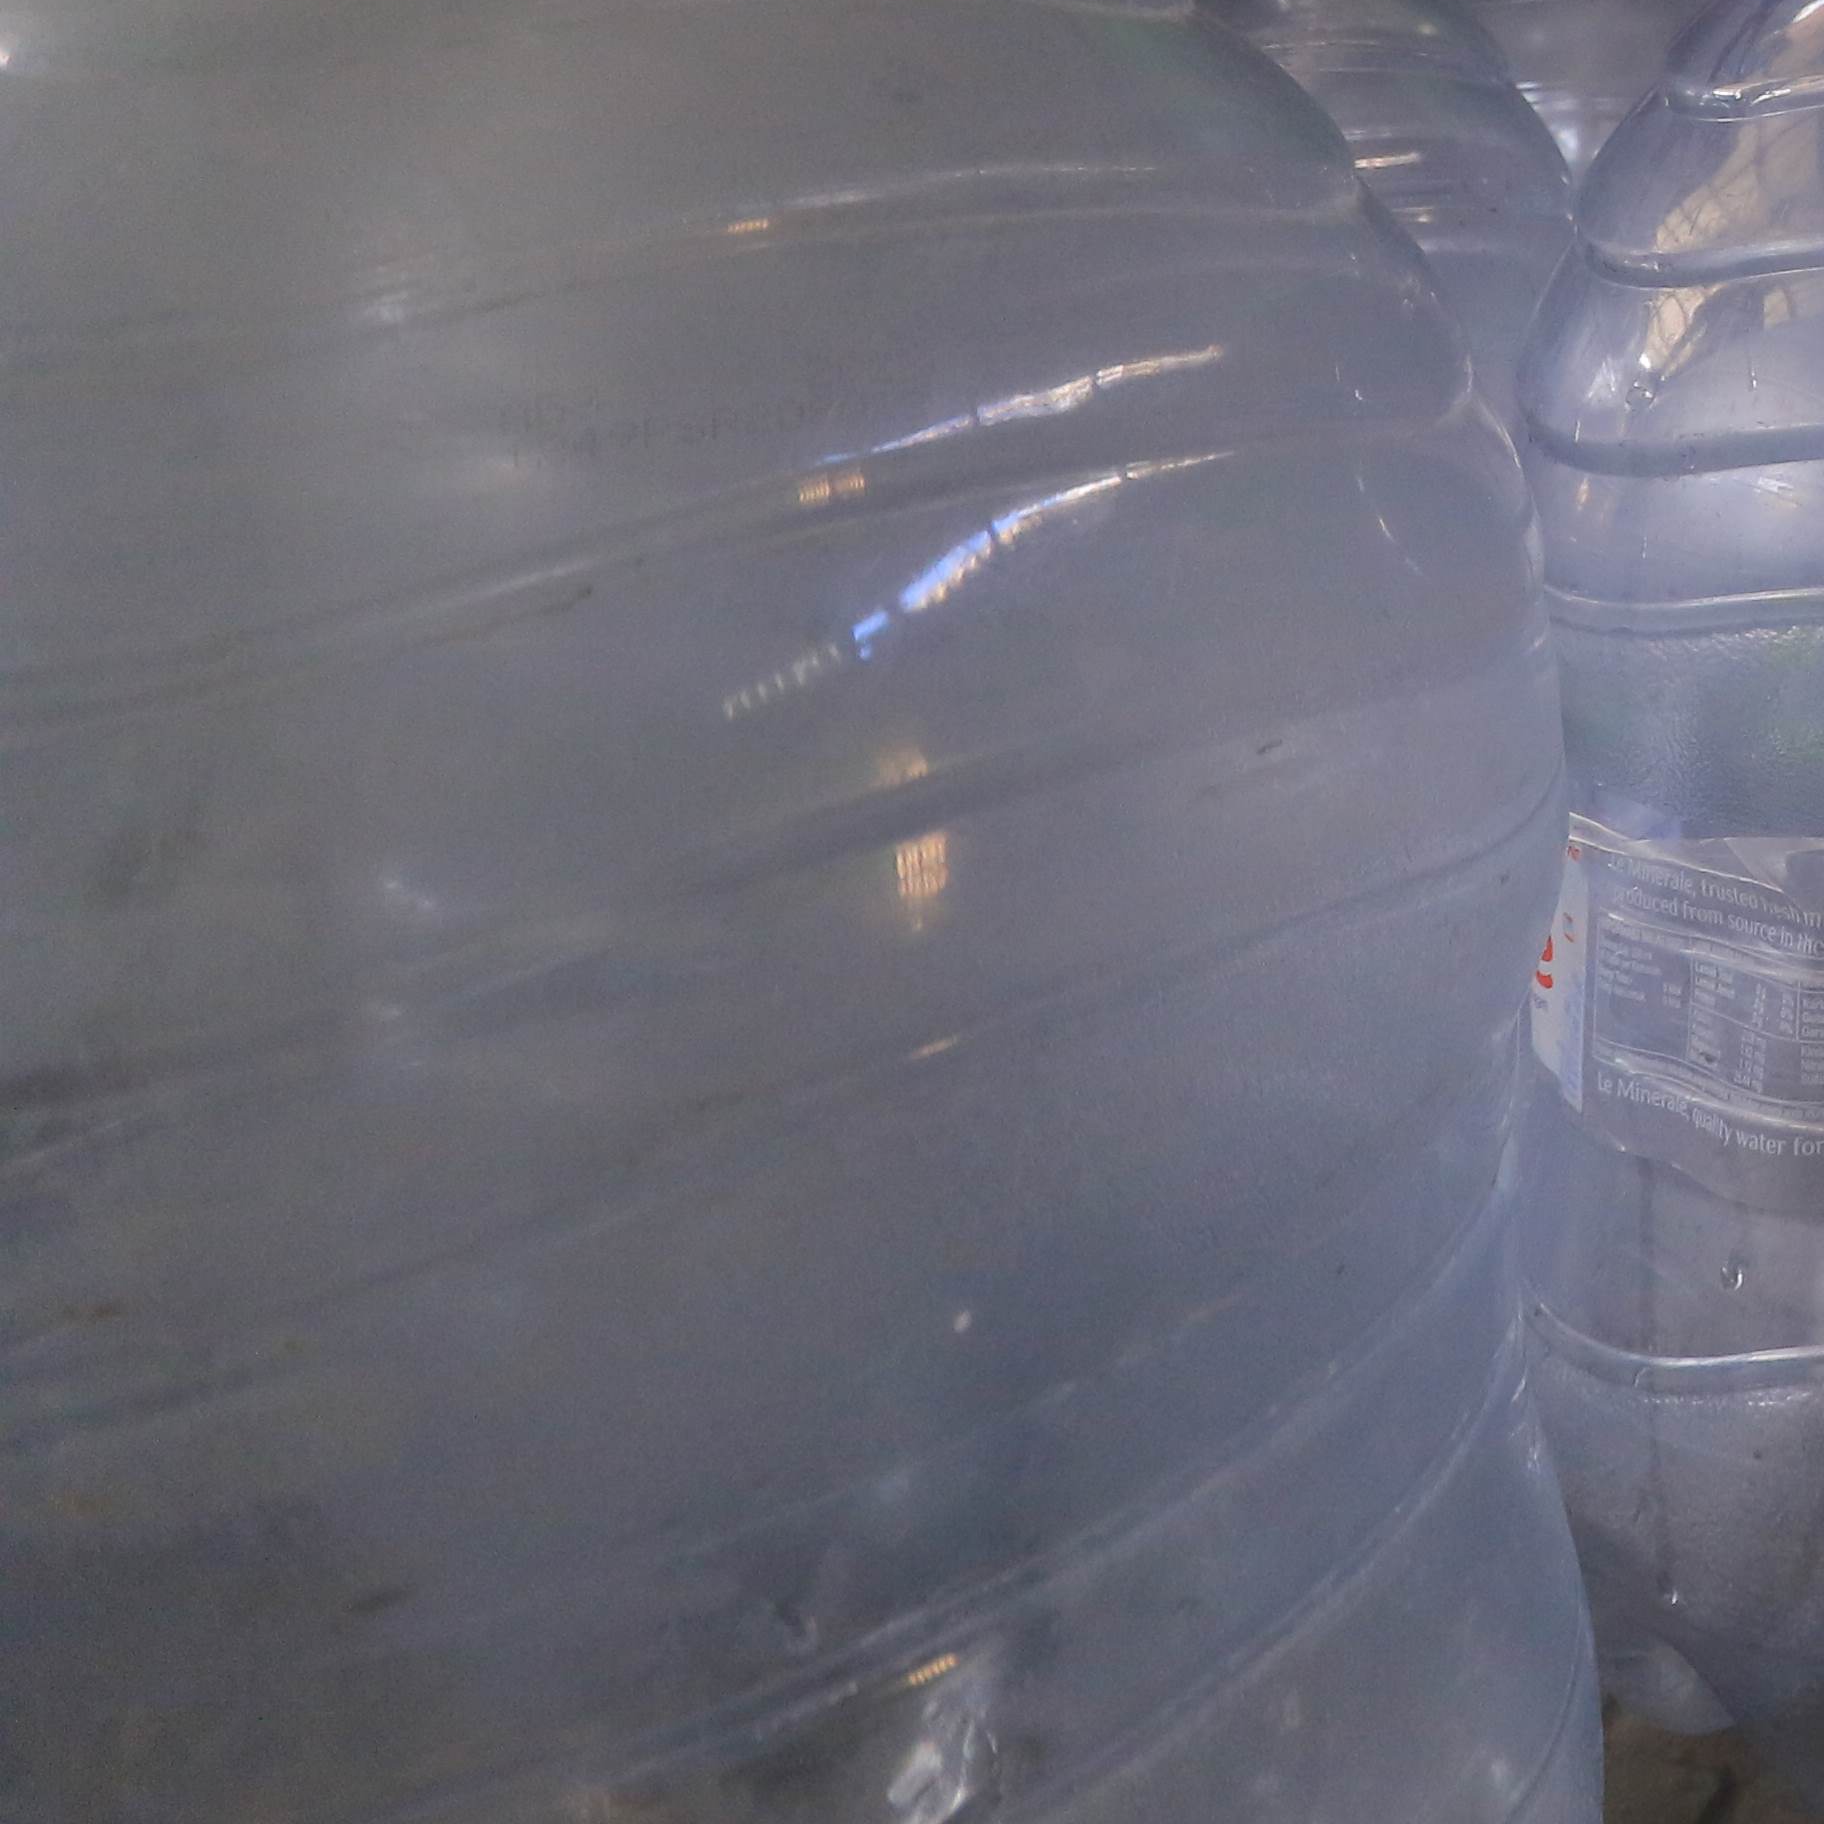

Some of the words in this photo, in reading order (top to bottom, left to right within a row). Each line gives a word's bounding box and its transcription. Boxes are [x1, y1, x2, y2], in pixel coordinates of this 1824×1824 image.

[1683, 901, 1724, 925] from
[1728, 915, 1777, 943] source
[1780, 926, 1793, 947] in
[1798, 933, 1824, 955] the
[1598, 1071, 1613, 1094] Le
[1735, 1130, 1786, 1155] water
[1793, 1136, 1824, 1156] for
